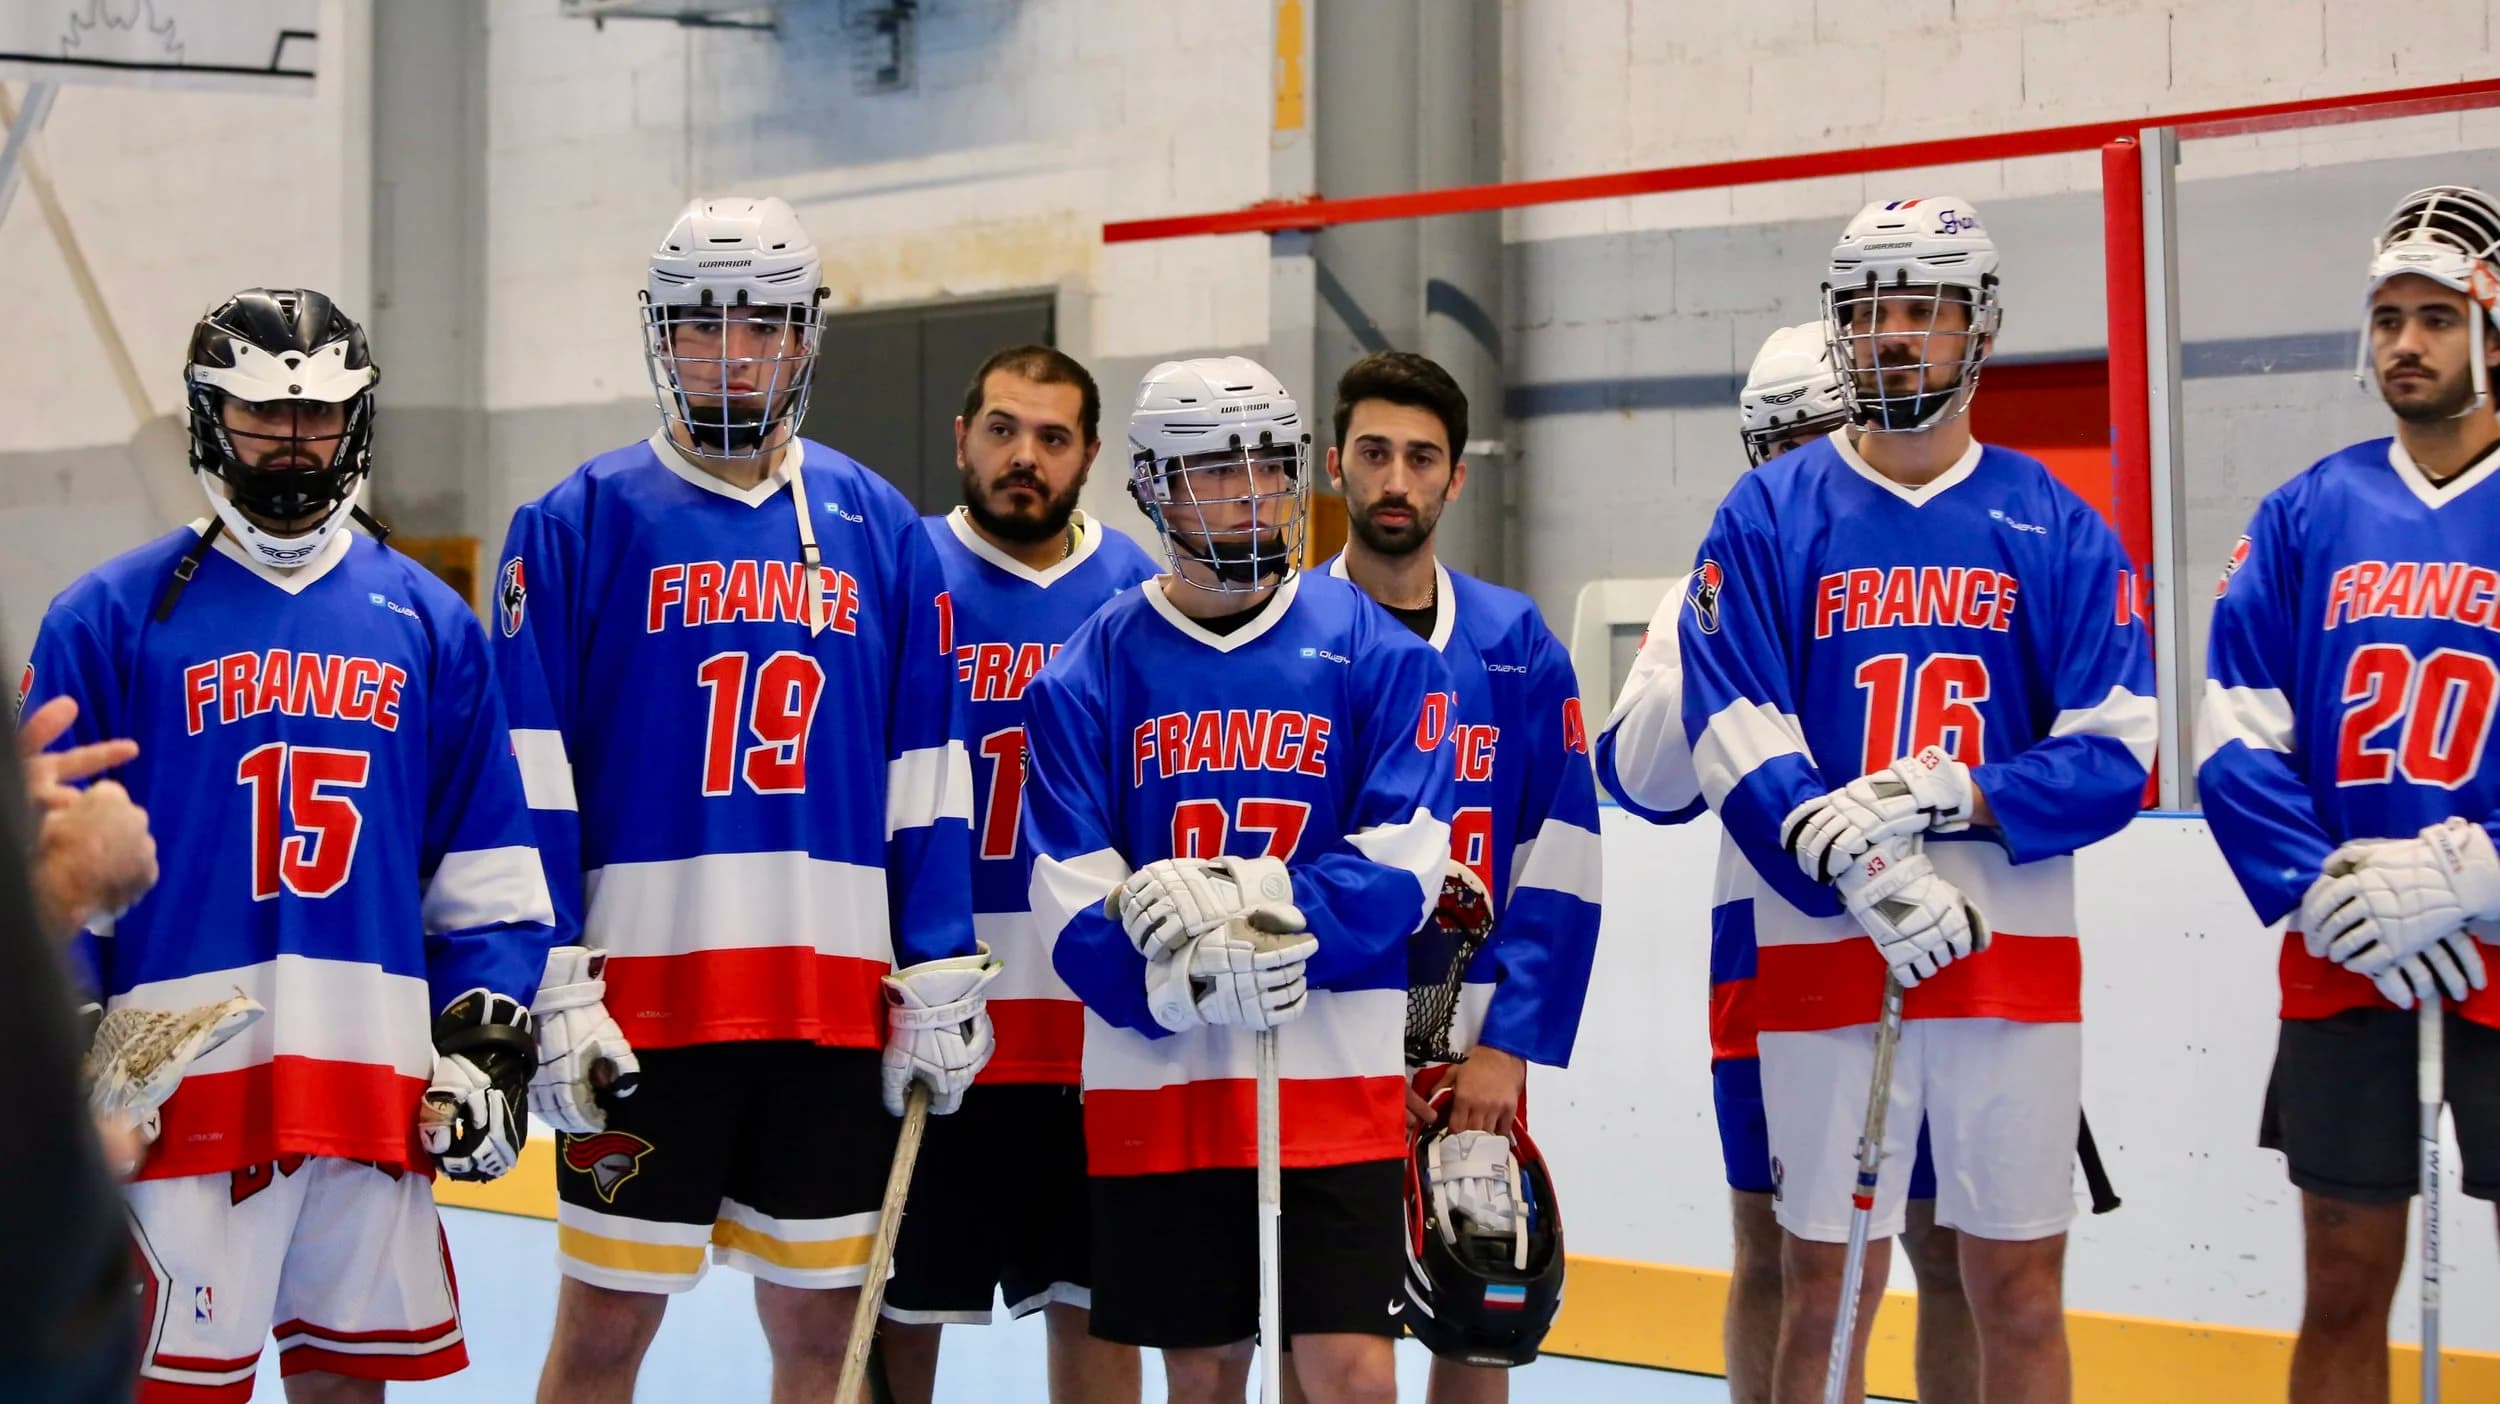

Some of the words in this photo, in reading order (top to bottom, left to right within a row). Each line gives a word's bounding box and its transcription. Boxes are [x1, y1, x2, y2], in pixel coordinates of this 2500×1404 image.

[698, 259, 752, 268] WARRIOR
[1863, 241, 1913, 251] WARRIOR
[1220, 402, 1270, 415] WARRIOR
[646, 559, 861, 637] FRANCE
[1814, 565, 2018, 641] FRANCE
[184, 648, 407, 736] FRANCE
[956, 643, 1065, 701] FRA
[697, 650, 826, 797] 19
[1132, 709, 1332, 789] FRANCE
[1855, 652, 1990, 776] 16
[2336, 642, 2500, 790] 20
[237, 741, 371, 902] 15
[1866, 856, 1886, 877] 33
